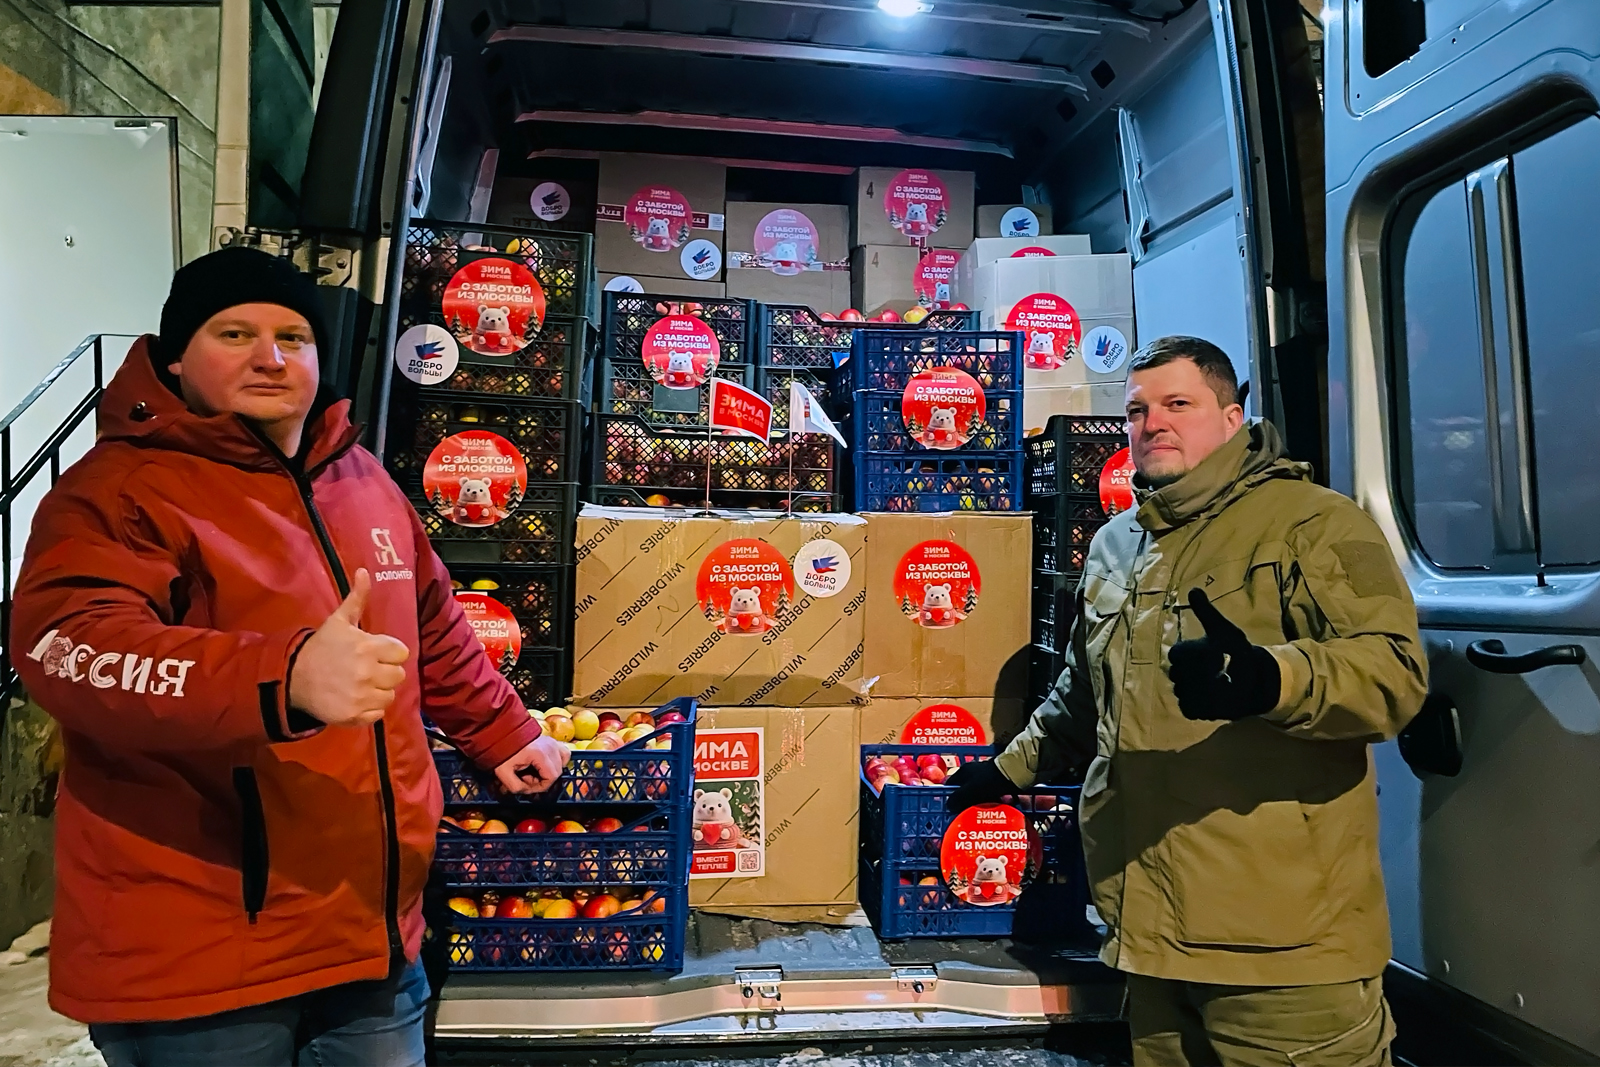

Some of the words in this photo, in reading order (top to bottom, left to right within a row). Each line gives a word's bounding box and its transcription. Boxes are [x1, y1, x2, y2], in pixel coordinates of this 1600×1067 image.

[866, 182, 874, 198] 4
[872, 252, 879, 268] 4
[481, 265, 512, 275] ЗИМА
[461, 282, 470, 290] С
[472, 284, 531, 294] ЗАБОТОЙ
[458, 291, 475, 299] ИЗ
[477, 292, 533, 303] МОСКВЫ
[1027, 313, 1071, 322] ЗАБОТОЙ
[1030, 320, 1072, 330] МОСКВЫ
[664, 334, 708, 342] ЗАБОТОЙ
[1102, 343, 1119, 366] ДОБРО
[409, 360, 442, 370] ДОБРО
[408, 367, 442, 377] ВОЛЬЦЫ
[926, 387, 974, 395] ЗАБОТОЙ
[930, 395, 976, 404] МОСКВЫ
[721, 394, 765, 421] ЗИМА
[728, 409, 765, 428] МОСКВЕ
[442, 455, 451, 463] С
[454, 455, 512, 464] ЗАБОТОЙ
[438, 464, 456, 472] ИЗ
[458, 465, 515, 473] МОСКВЫ
[371, 528, 404, 565] Я
[712, 565, 722, 573] С
[723, 562, 779, 573] ЗАБОТОЙ
[918, 561, 967, 571] ЗАБОТОЙ
[710, 574, 726, 582] ИЗ
[728, 573, 782, 582] МОСКВЫ
[806, 572, 836, 584] ДОБРО
[922, 571, 970, 579] МОСКВЫ
[616, 562, 686, 626] WILDBERRIES
[475, 629, 510, 637] СКВЫ
[590, 641, 660, 702] WILDBERRIES
[924, 726, 974, 735] ЗАБОТОЙ
[929, 736, 977, 744] МОСКВЫ
[695, 740, 748, 759] ИМА
[977, 811, 1006, 819] ЗИМА
[958, 831, 967, 840] С
[969, 829, 1027, 840] ЗАБОТОЙ
[956, 842, 972, 850] ИЗ
[975, 842, 1030, 850] МОСКВЫ
[696, 856, 729, 864] ВМЕСТЕ
